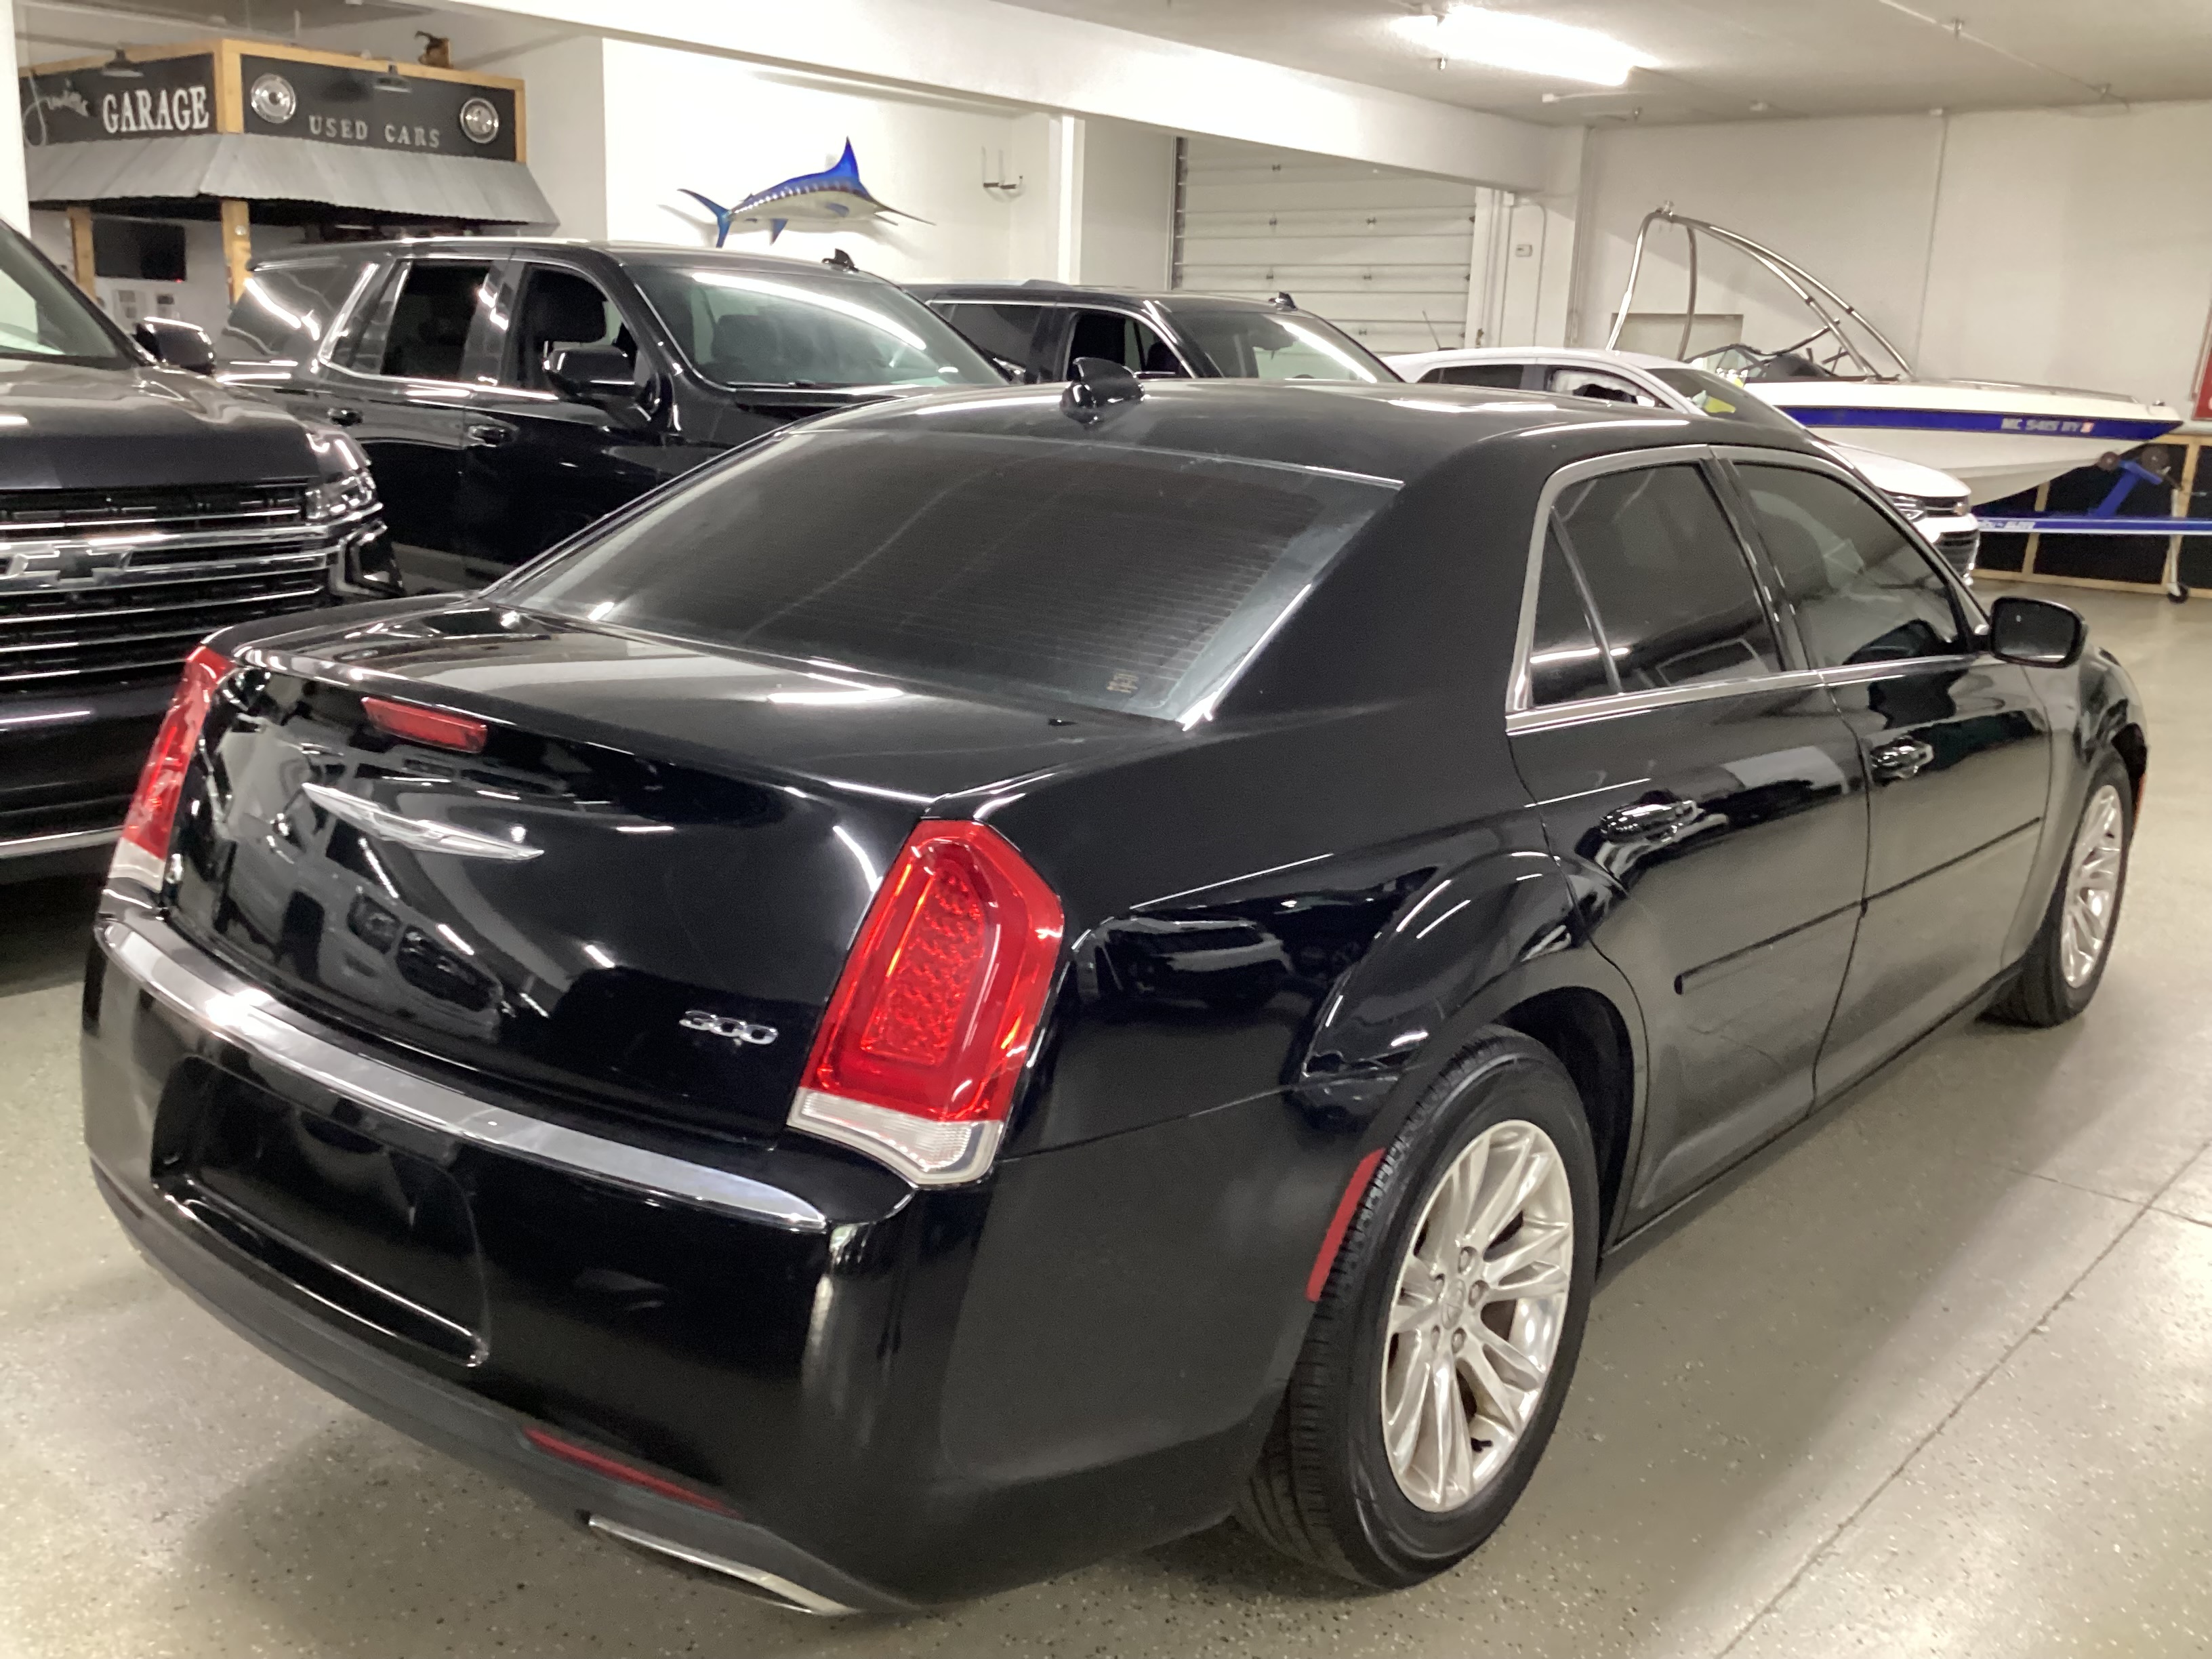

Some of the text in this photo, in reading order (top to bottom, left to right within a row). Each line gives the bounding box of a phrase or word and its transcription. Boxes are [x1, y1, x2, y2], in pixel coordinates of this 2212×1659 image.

[102, 85, 209, 134] GARAGE
[309, 115, 440, 148] USED CARS
[679, 1009, 779, 1045] 300
